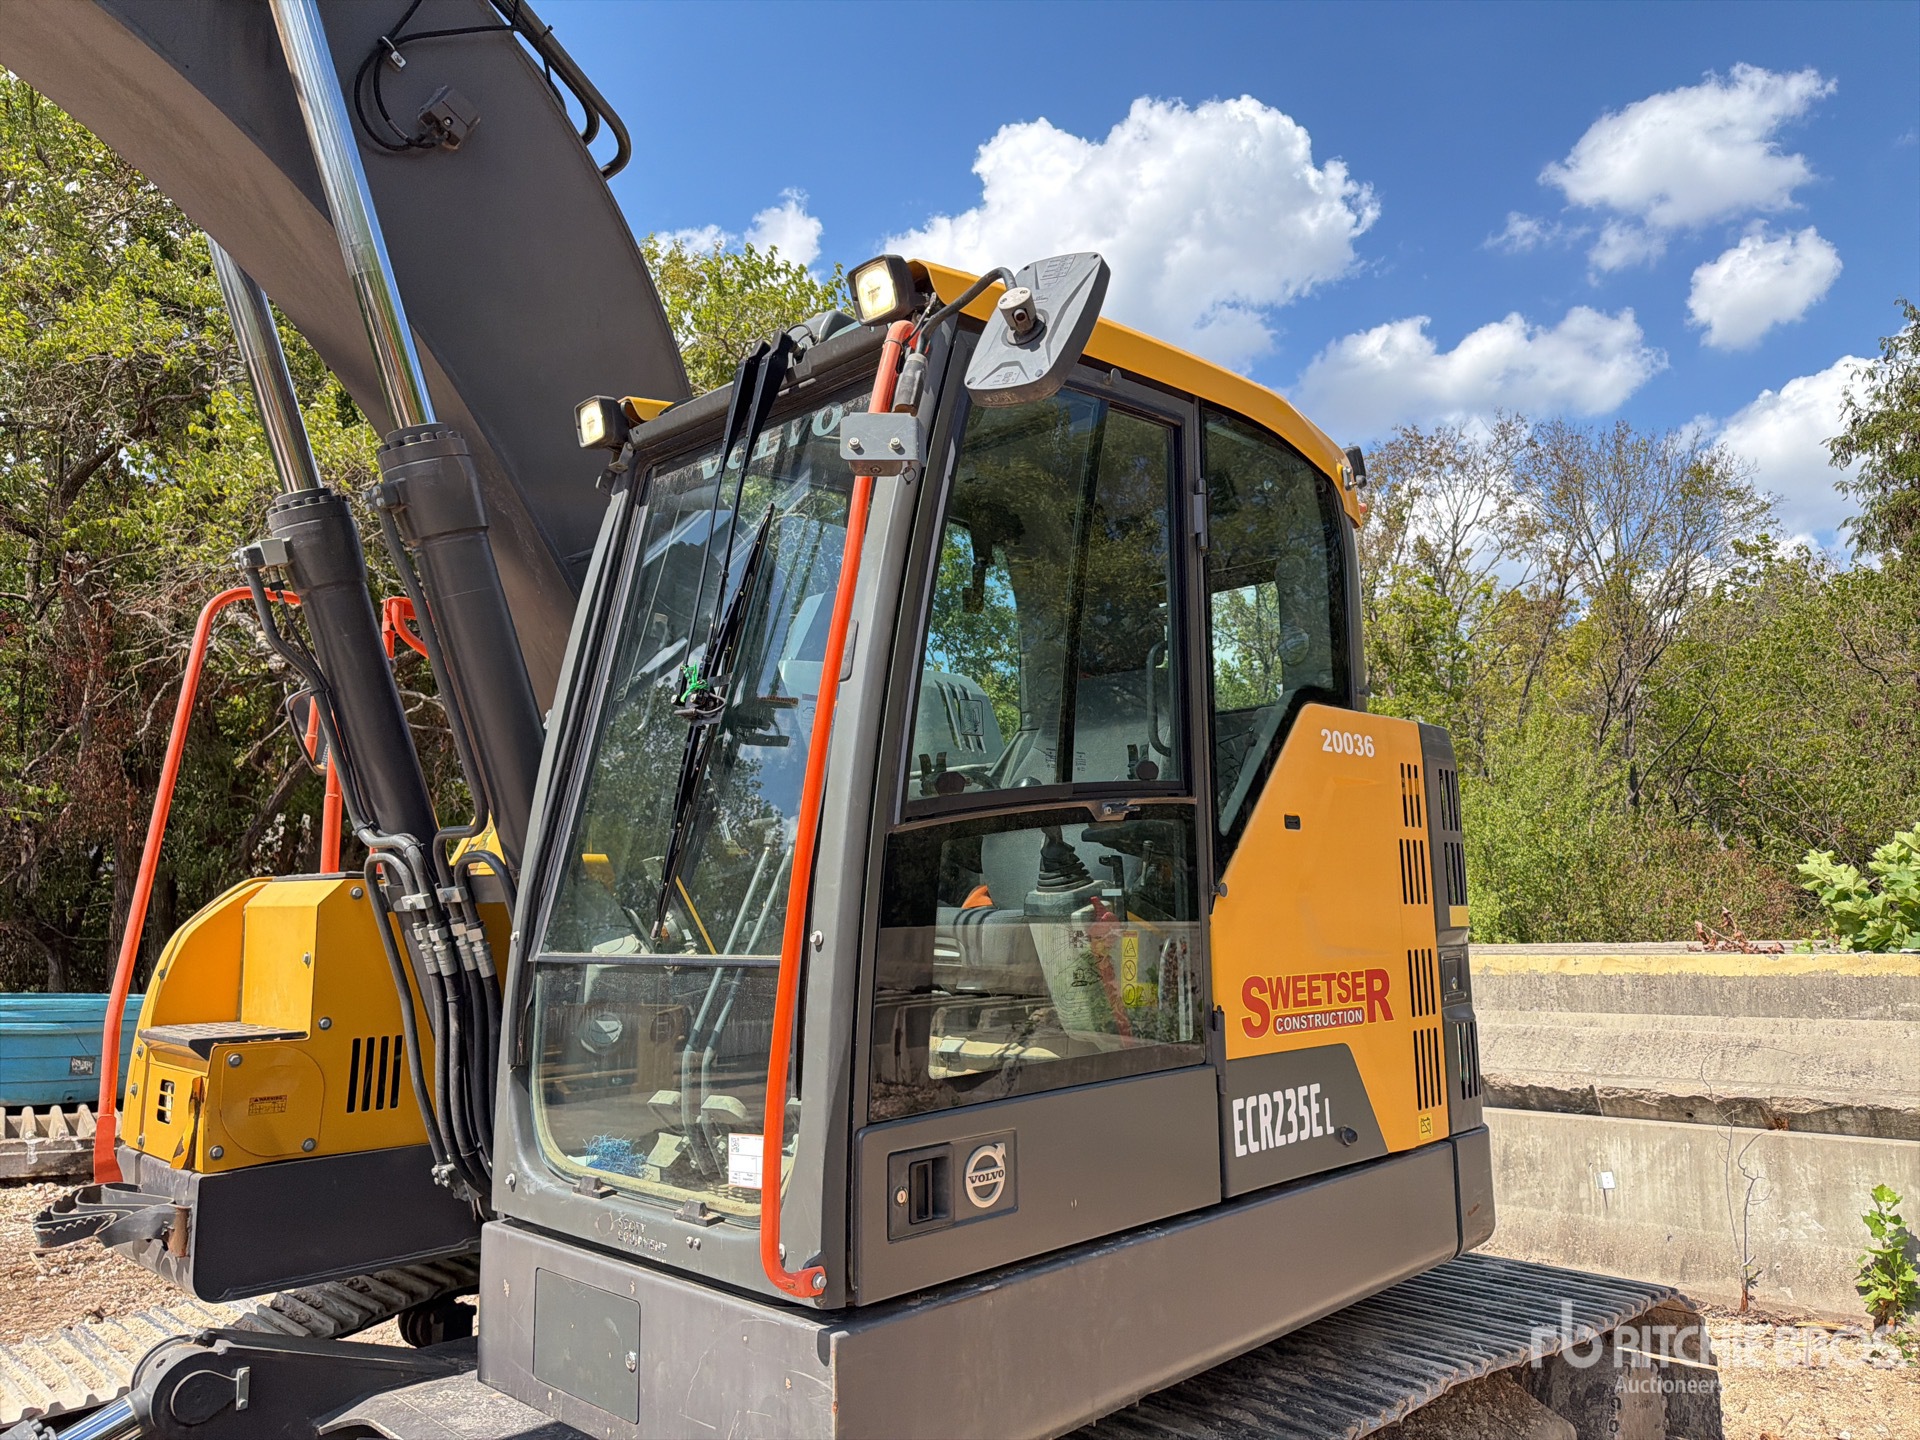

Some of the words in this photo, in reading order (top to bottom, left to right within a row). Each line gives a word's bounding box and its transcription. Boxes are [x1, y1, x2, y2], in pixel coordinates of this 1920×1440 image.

[1320, 728, 1375, 758] 20036
[1241, 968, 1395, 1039] SWEETSER
[1275, 1009, 1364, 1033] CONSTRUCTION
[968, 1169, 1004, 1184] VOLVO
